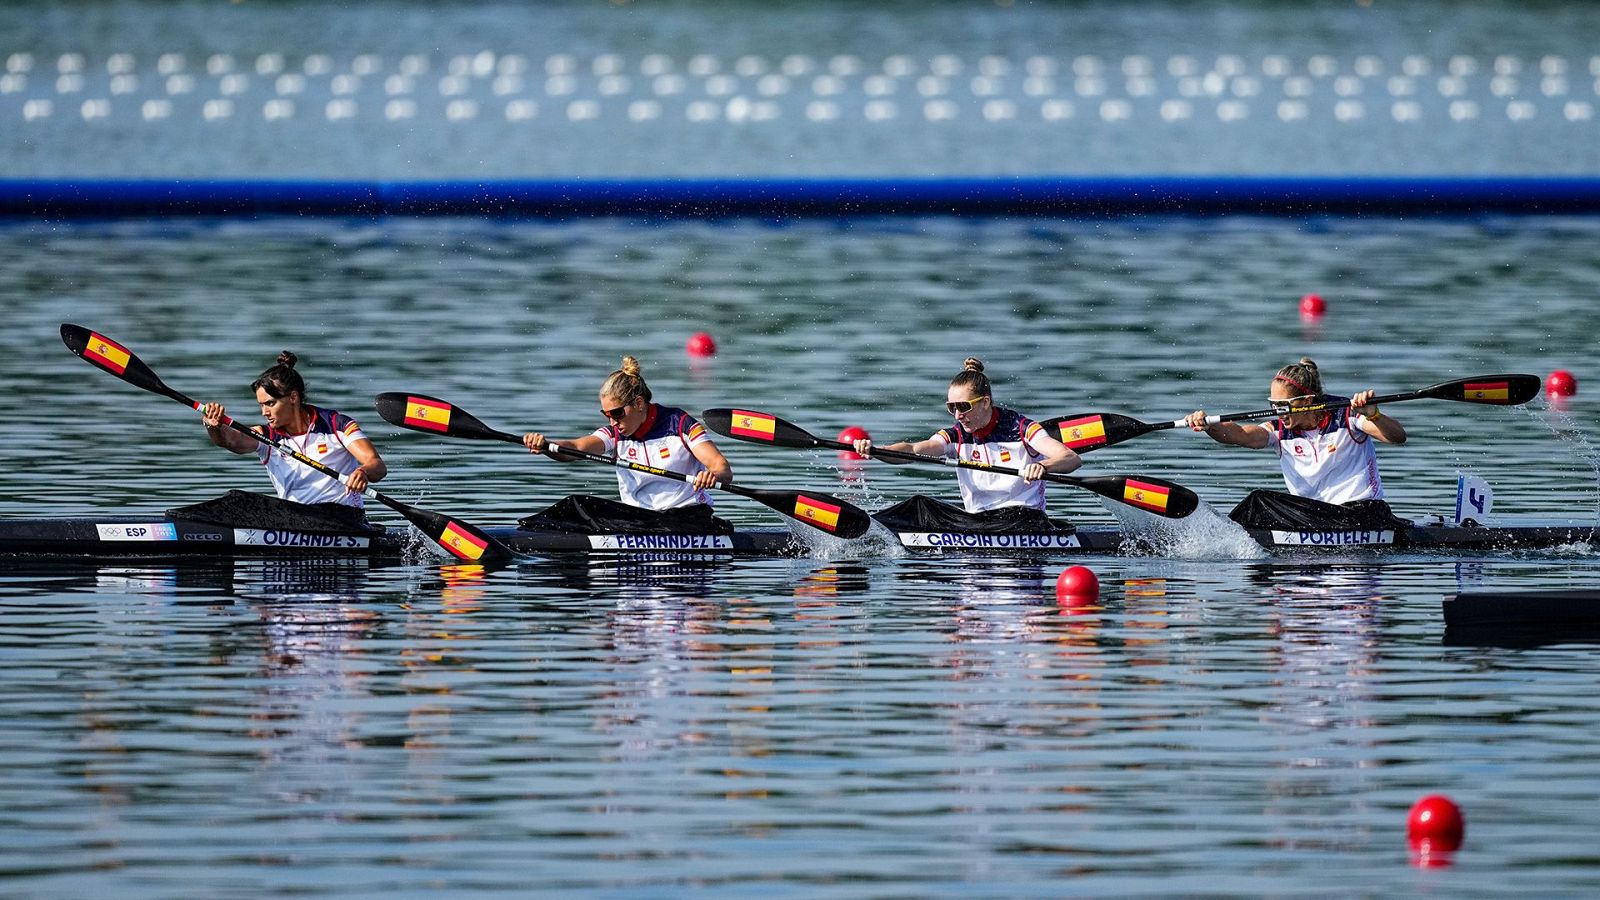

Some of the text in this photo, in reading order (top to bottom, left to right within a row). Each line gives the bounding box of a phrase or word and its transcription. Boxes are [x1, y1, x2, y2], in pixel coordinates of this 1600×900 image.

[1469, 487, 1485, 514] 4
[125, 527, 147, 537] ESP
[184, 533, 222, 541] NELO
[263, 529, 361, 548] OUZANDE S.
[1299, 531, 1369, 544] PORTELA
[616, 535, 725, 548] FERNANDEZ E.
[927, 534, 1074, 547] GARCIA OTERO C.
